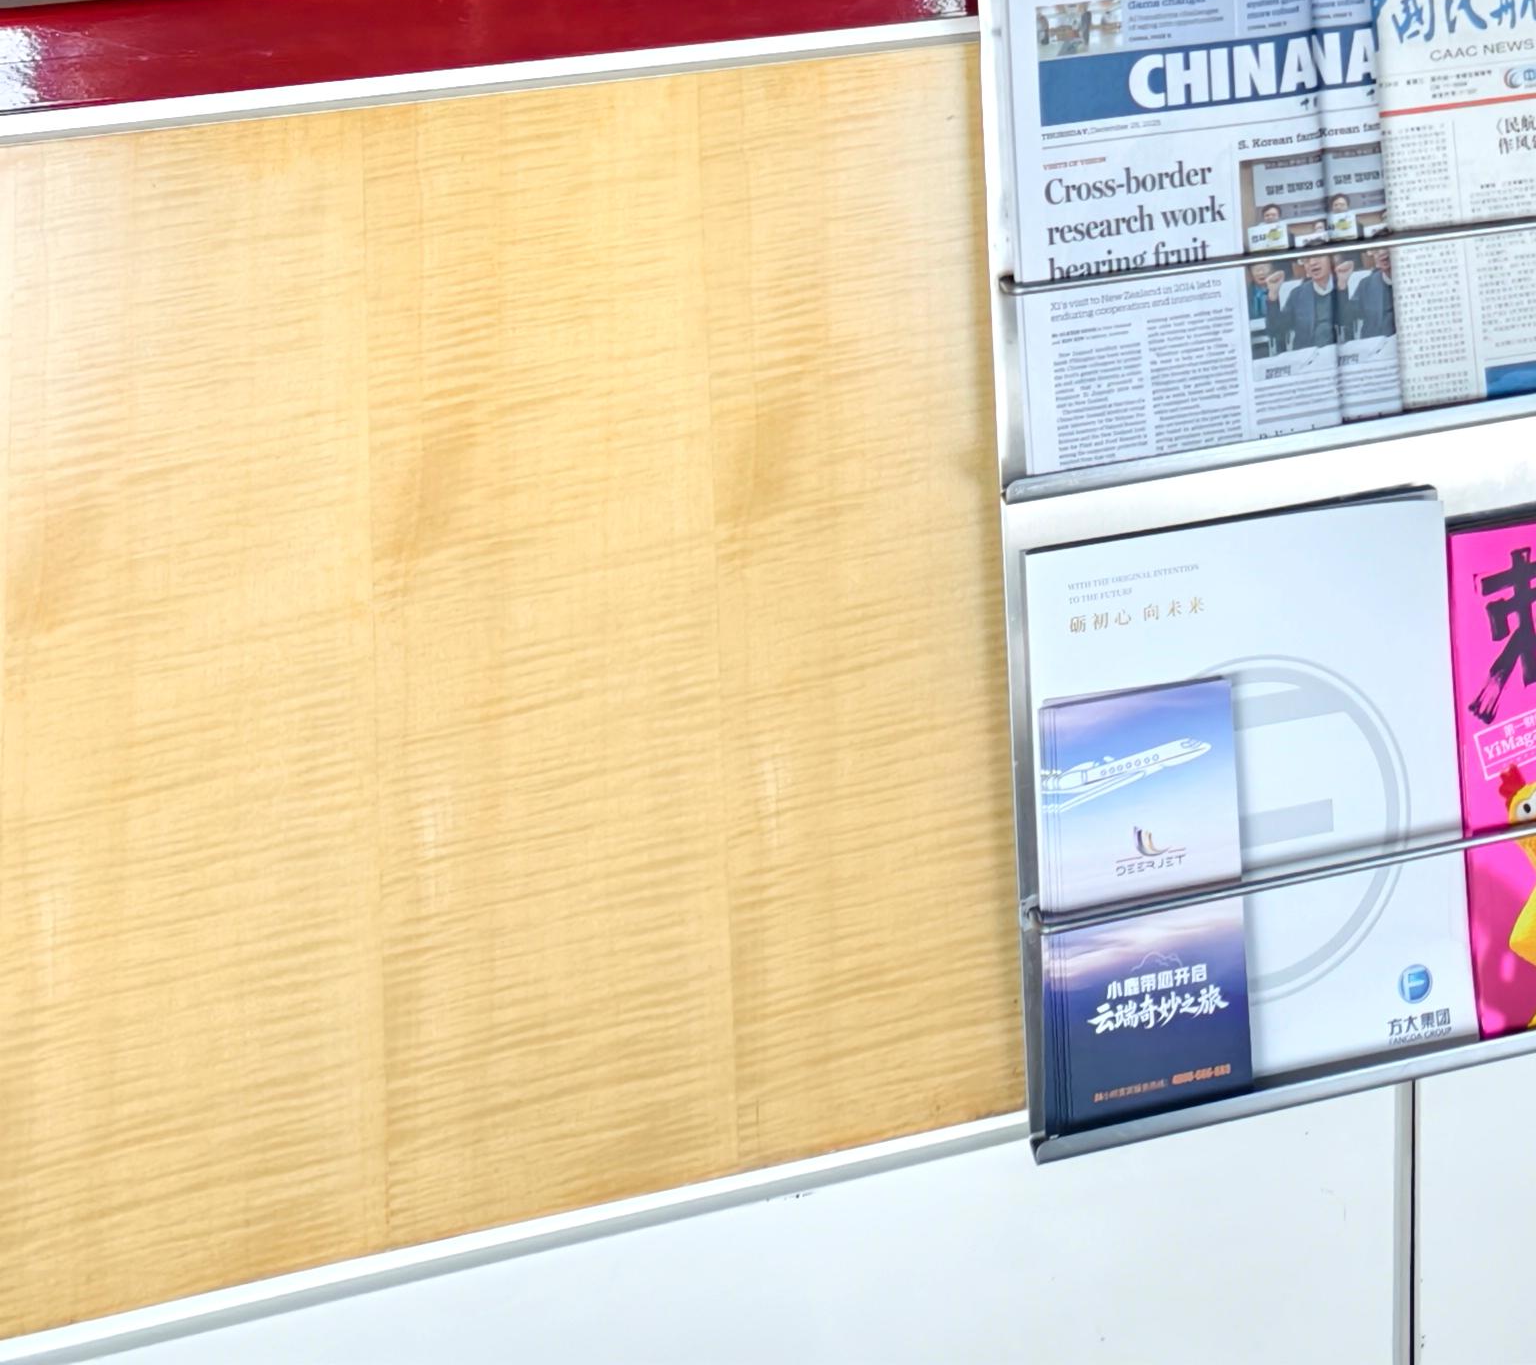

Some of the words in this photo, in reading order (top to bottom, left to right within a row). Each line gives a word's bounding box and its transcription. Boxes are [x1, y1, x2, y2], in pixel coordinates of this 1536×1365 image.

[1430, 45, 1478, 62] CAAC
[1483, 38, 1535, 57] NEWS
[1252, 134, 1293, 149] Korean
[1044, 160, 1213, 206] Cross-border
[1047, 202, 1156, 248] research
[1160, 195, 1227, 229] work
[1152, 238, 1211, 267] fruit
[1069, 297, 1089, 310] visit
[1090, 296, 1100, 305] to
[1101, 293, 1122, 305] New
[1123, 287, 1162, 301] Zealand
[1163, 285, 1173, 295] in
[1174, 282, 1195, 294] 2014
[1196, 279, 1212, 291] led
[1212, 278, 1222, 288] to
[1095, 301, 1151, 319] cooperation
[1151, 297, 1170, 308] and
[1068, 580, 1091, 591] WITH
[1093, 577, 1110, 588] THE
[1111, 571, 1152, 584] ORIGINAL
[1153, 563, 1200, 578] INTENTION
[1069, 595, 1080, 605] TO
[1082, 592, 1098, 603] THE
[1100, 587, 1133, 600] FUTURE
[1070, 608, 1132, 634] 砺初心
[1143, 596, 1206, 622] 向未来
[1087, 984, 1230, 1036] 云端奇妙之旅
[1387, 1008, 1451, 1037] 方大集团
[1389, 1033, 1423, 1046] FANGDA
[1424, 1026, 1452, 1040] GROUP
